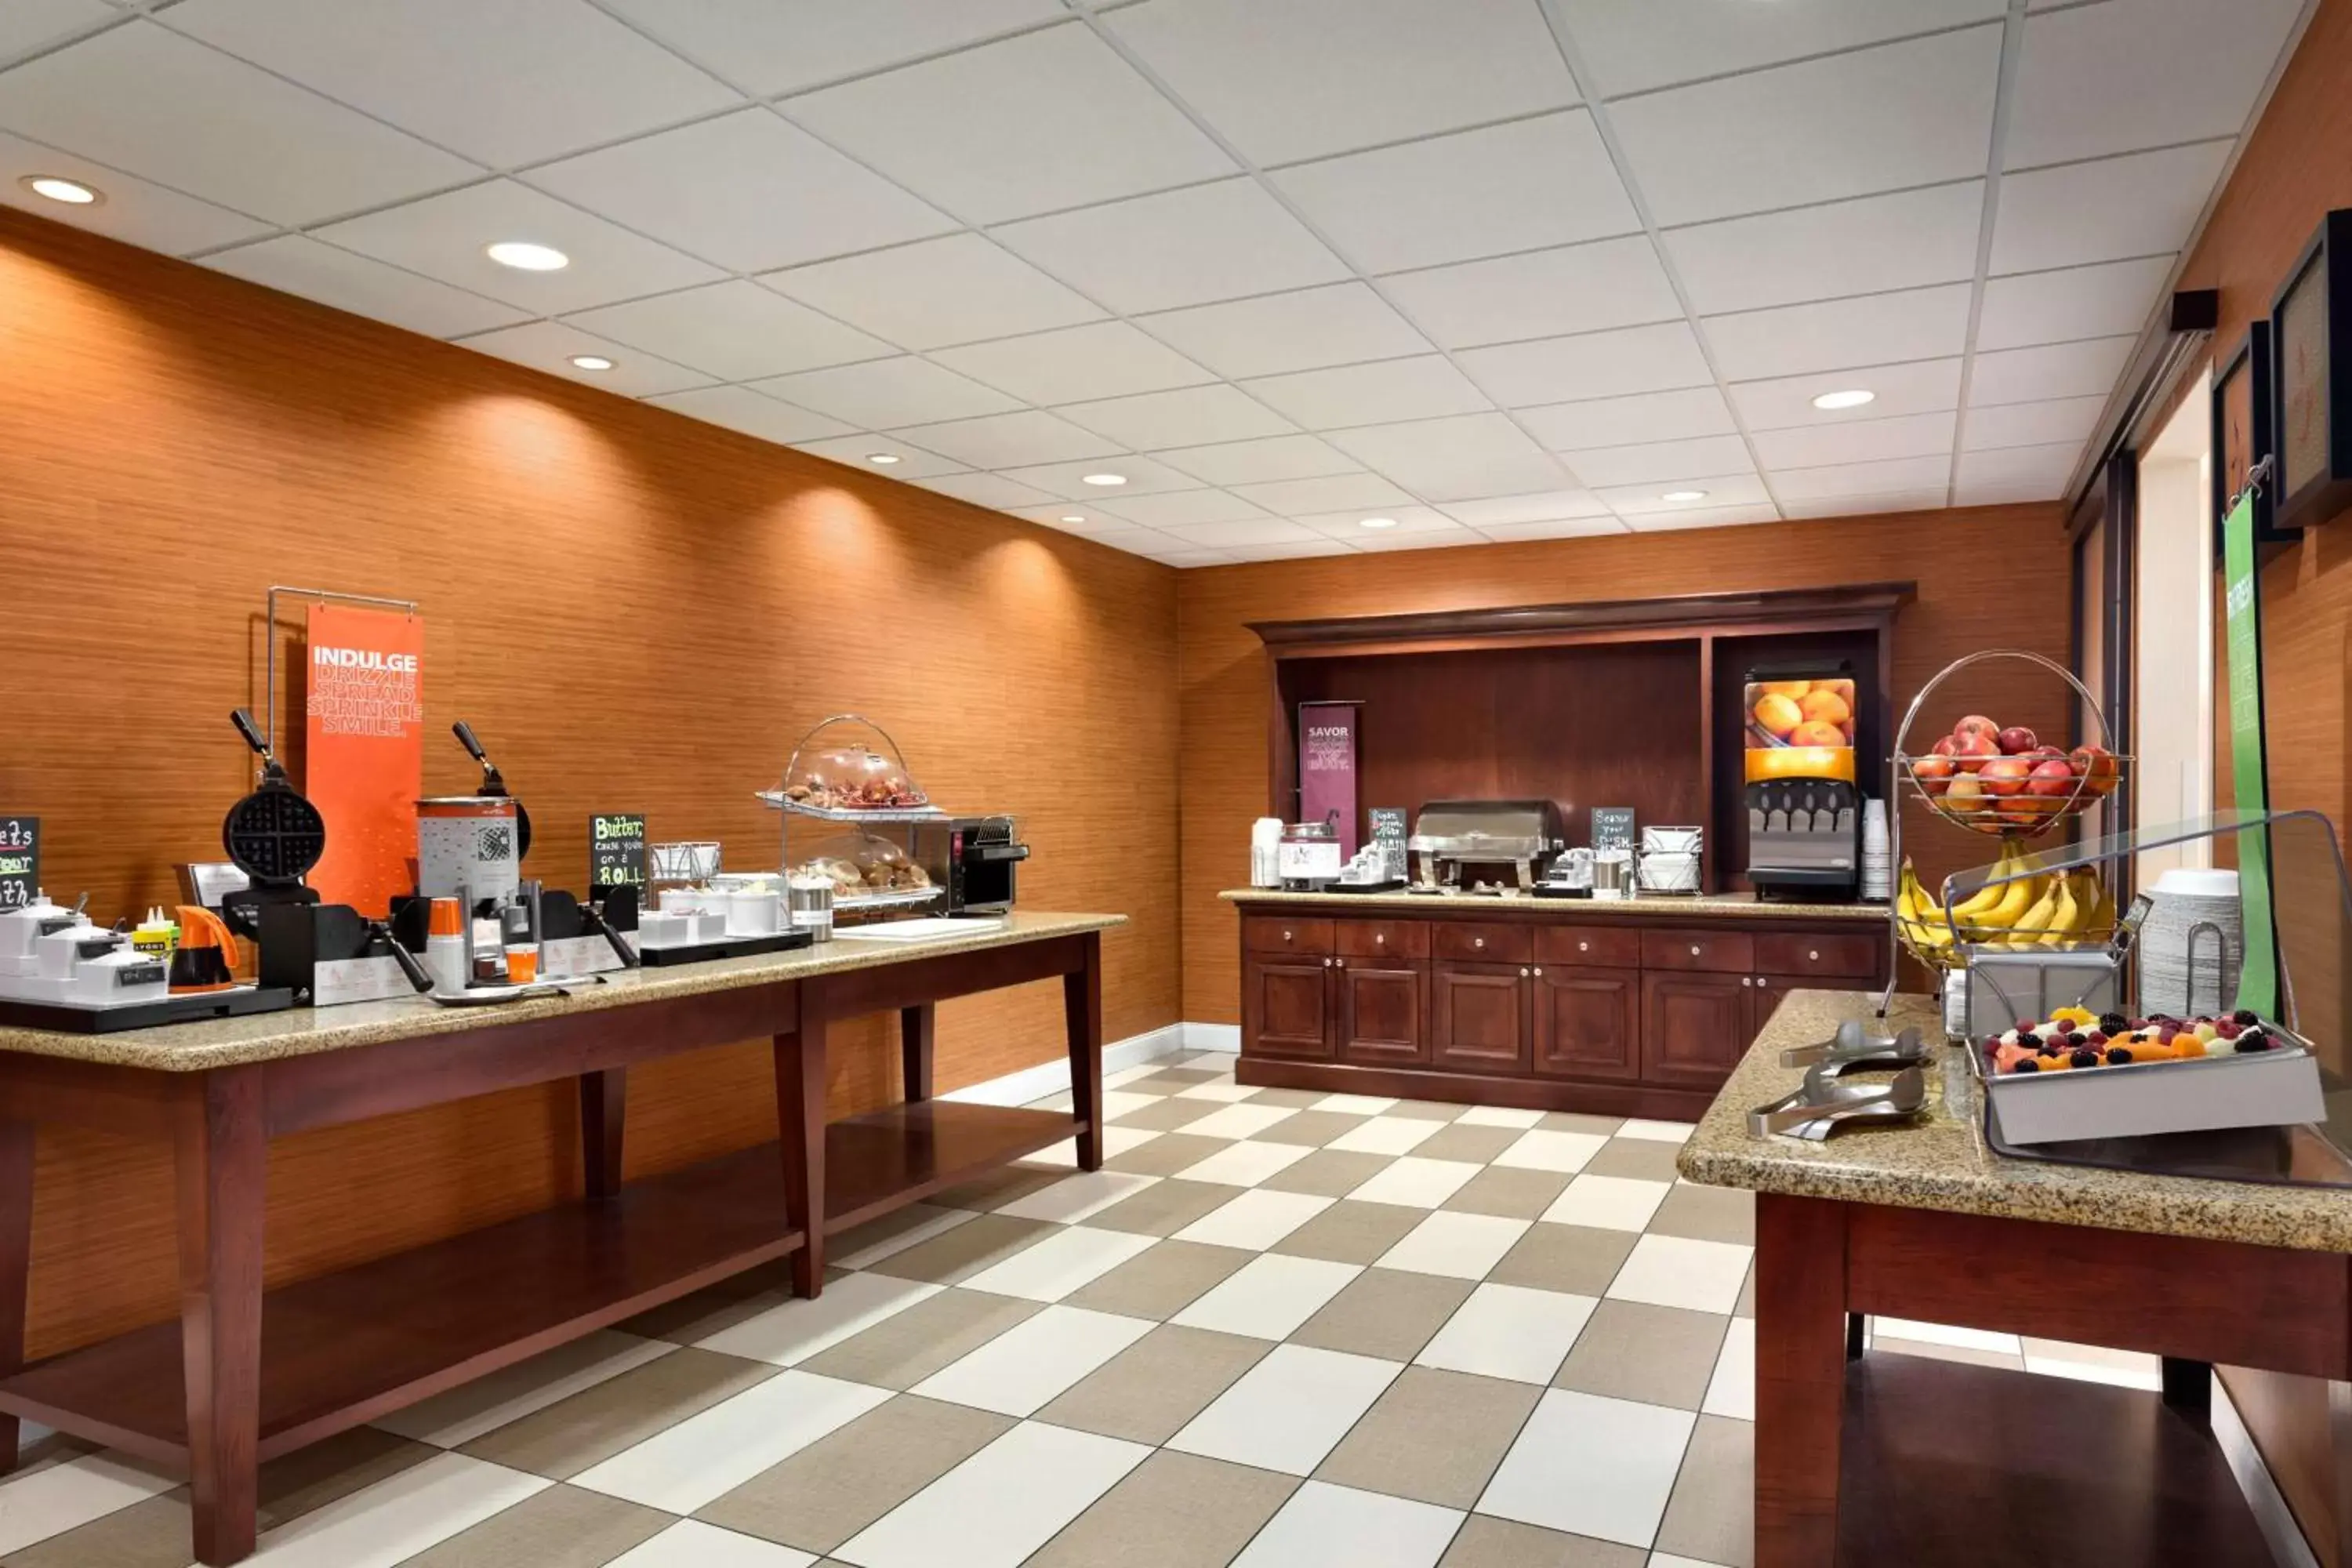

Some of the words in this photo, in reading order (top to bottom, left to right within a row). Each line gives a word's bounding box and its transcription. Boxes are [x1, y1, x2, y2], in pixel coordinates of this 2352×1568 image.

[314, 645, 418, 673] INDULGE
[317, 665, 416, 688] DRIZZLE
[316, 681, 416, 704] SPREAD
[308, 695, 423, 722] SPRINKLE
[1308, 727, 1348, 737] SAVOR
